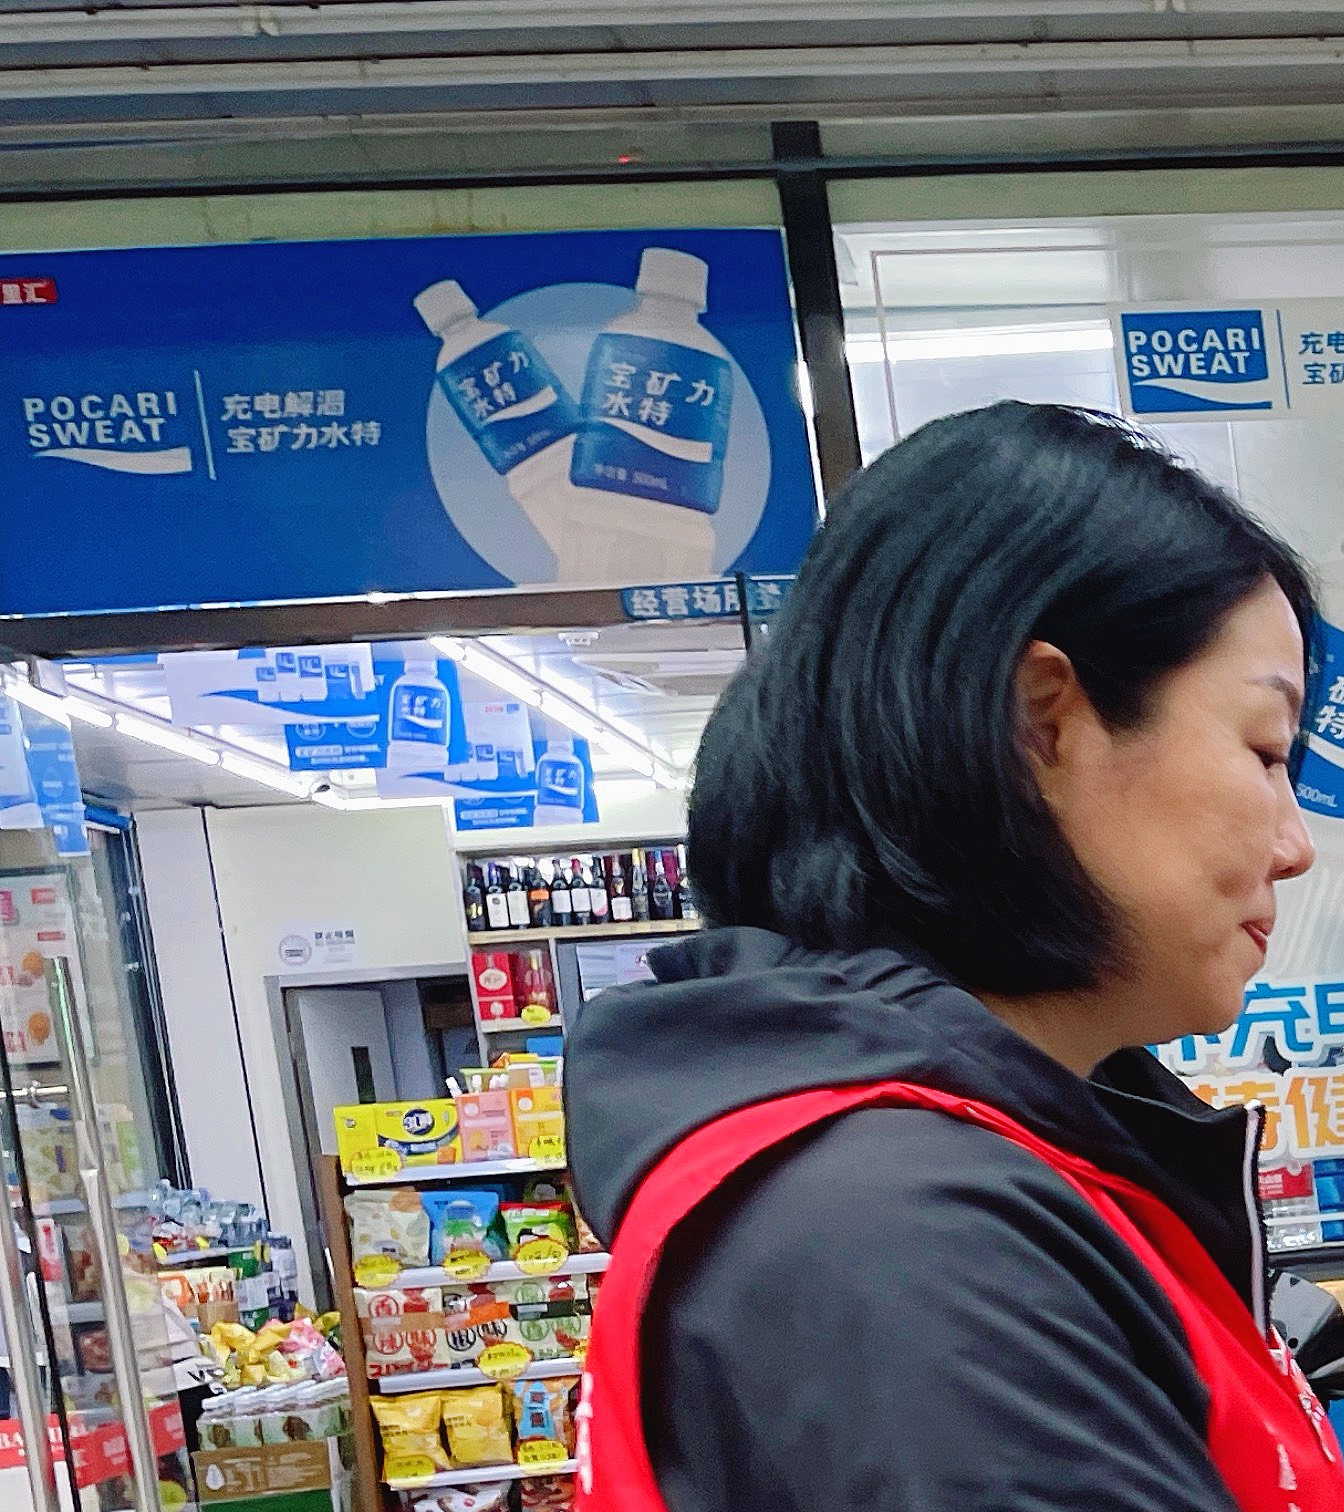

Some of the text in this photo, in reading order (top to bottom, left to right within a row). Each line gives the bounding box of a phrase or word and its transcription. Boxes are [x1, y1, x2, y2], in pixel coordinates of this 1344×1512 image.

[1128, 326, 1261, 353] POCARI
[1131, 351, 1250, 377] SWEAT
[605, 362, 716, 407] 宝矿力
[23, 391, 178, 422] POCARI
[602, 390, 673, 426] 水特
[28, 417, 166, 448] SWEAT
[226, 420, 382, 453] 宝矿力水特
